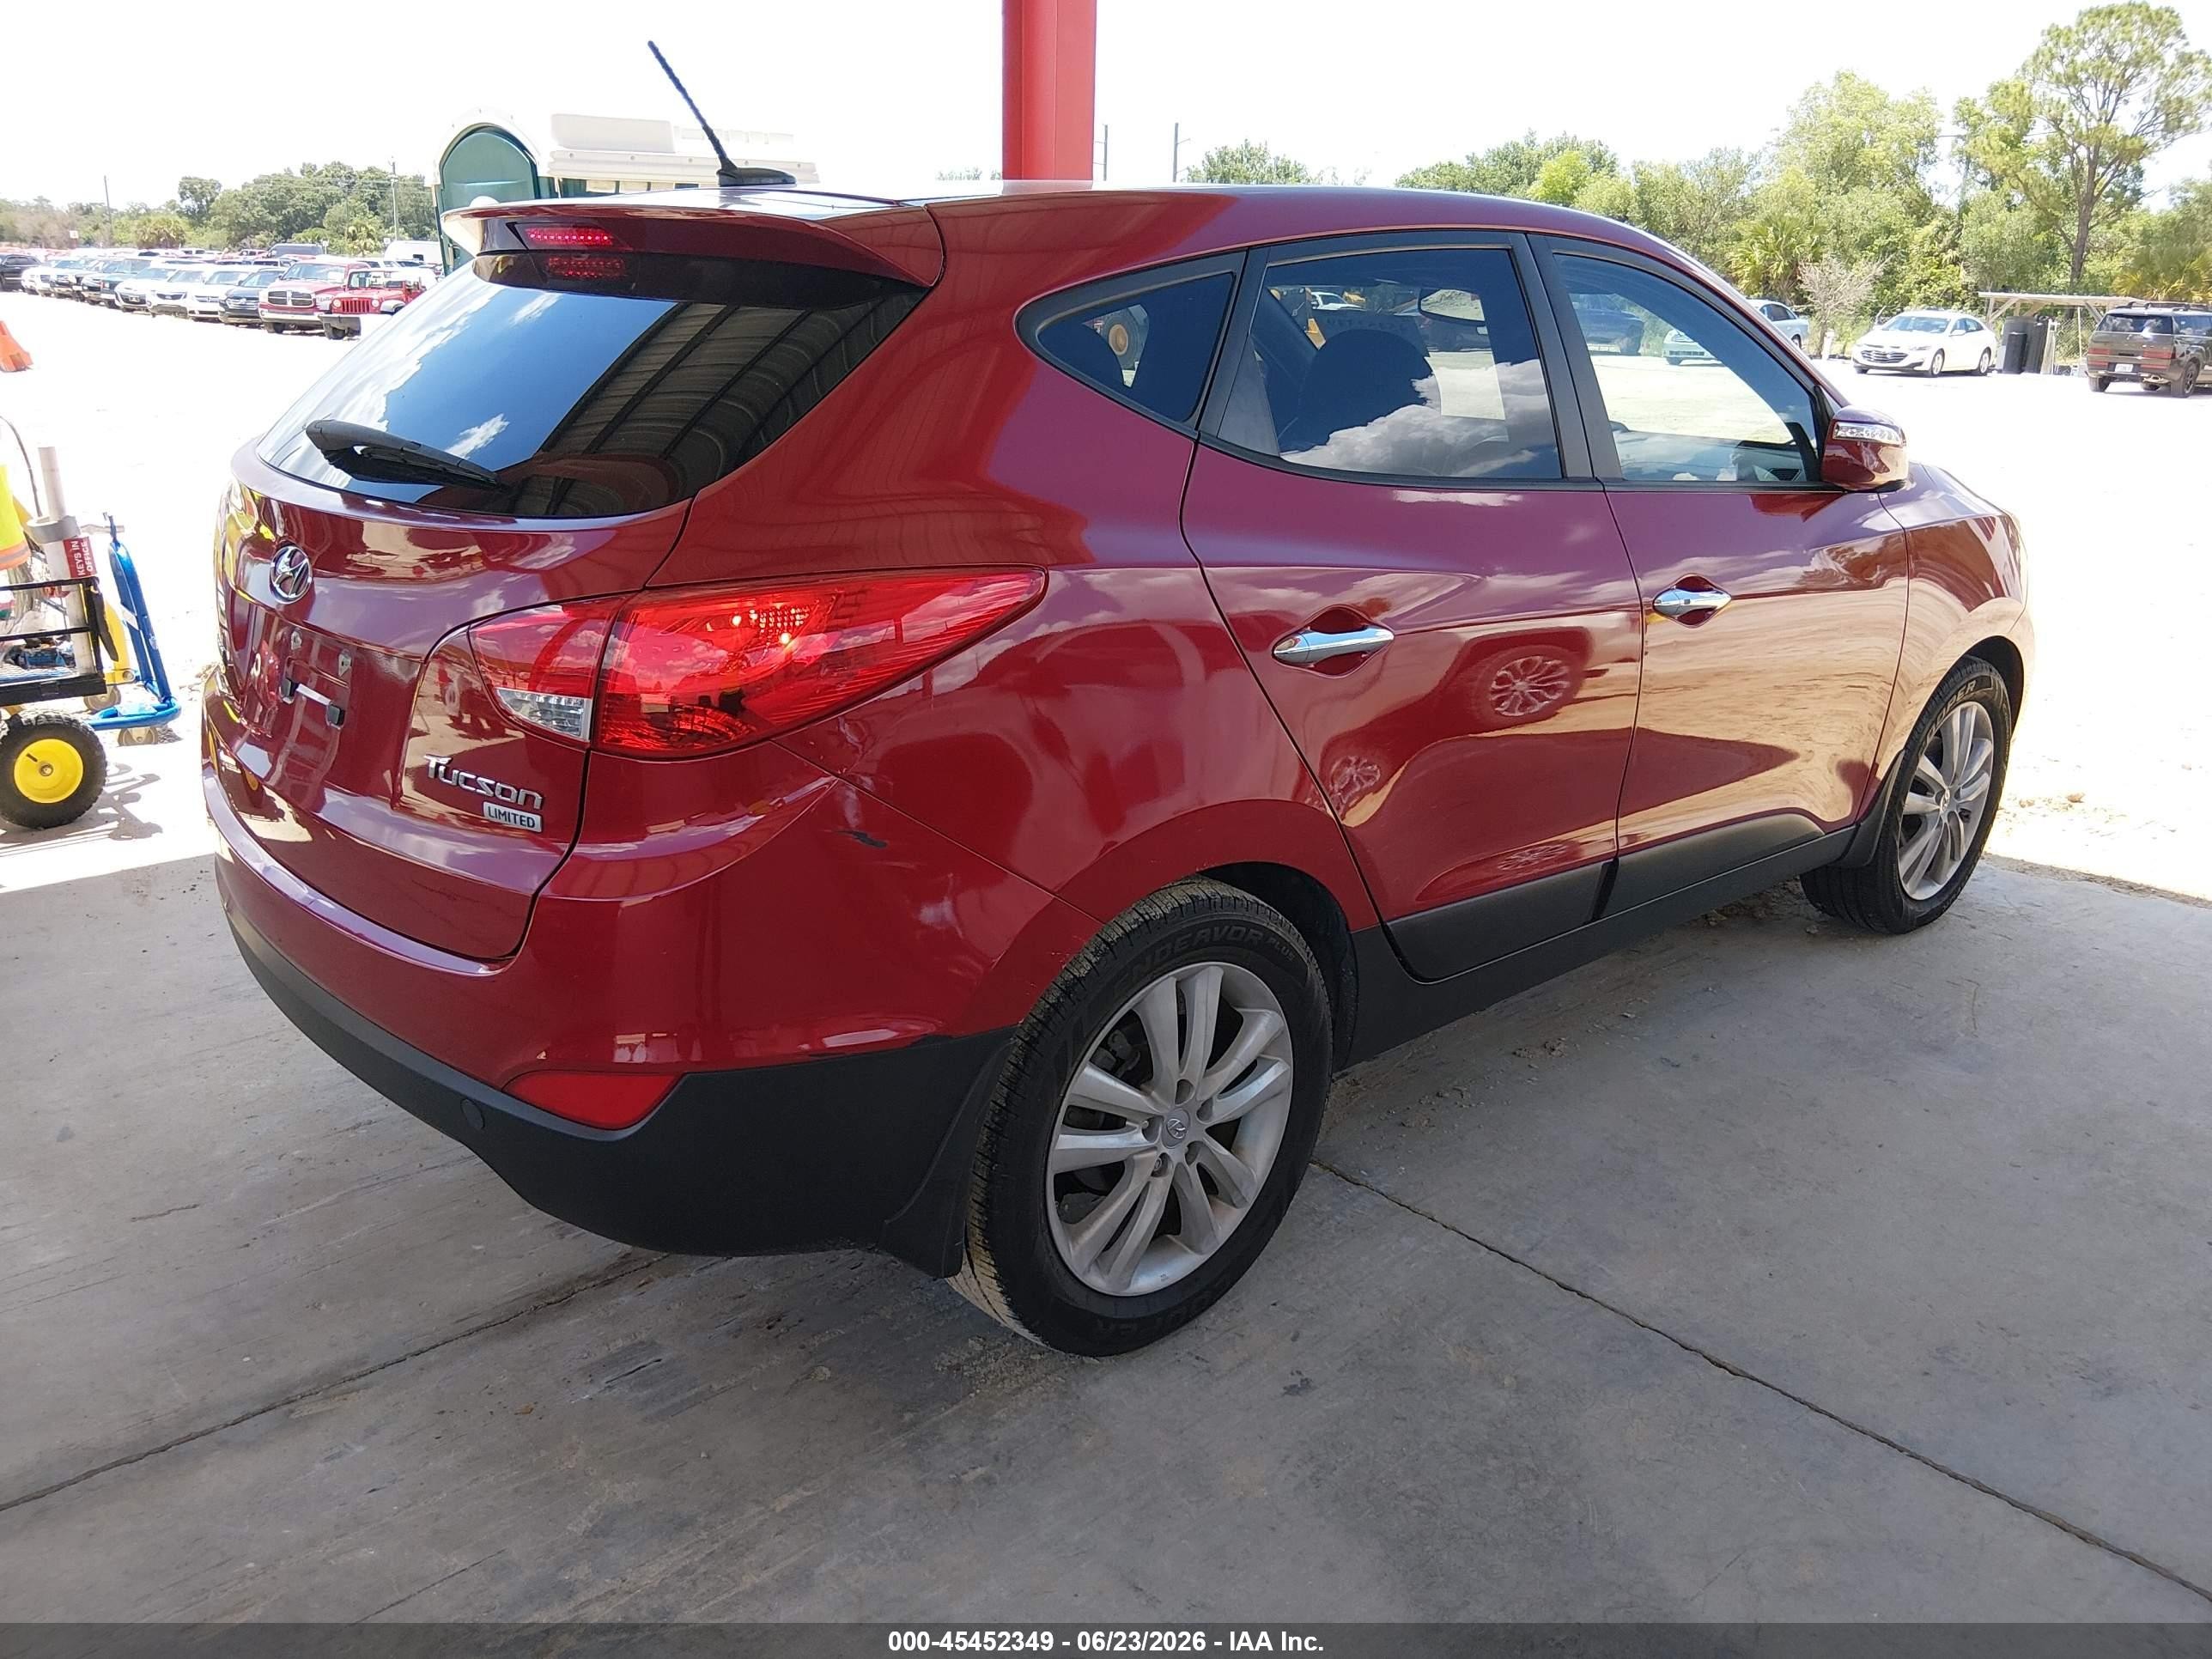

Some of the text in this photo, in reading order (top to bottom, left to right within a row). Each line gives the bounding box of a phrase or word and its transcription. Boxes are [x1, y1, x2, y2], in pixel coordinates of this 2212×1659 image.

[70, 540, 86, 575] KEYS IN
[81, 540, 94, 572] OFFICE
[487, 805, 536, 829] LIMITED
